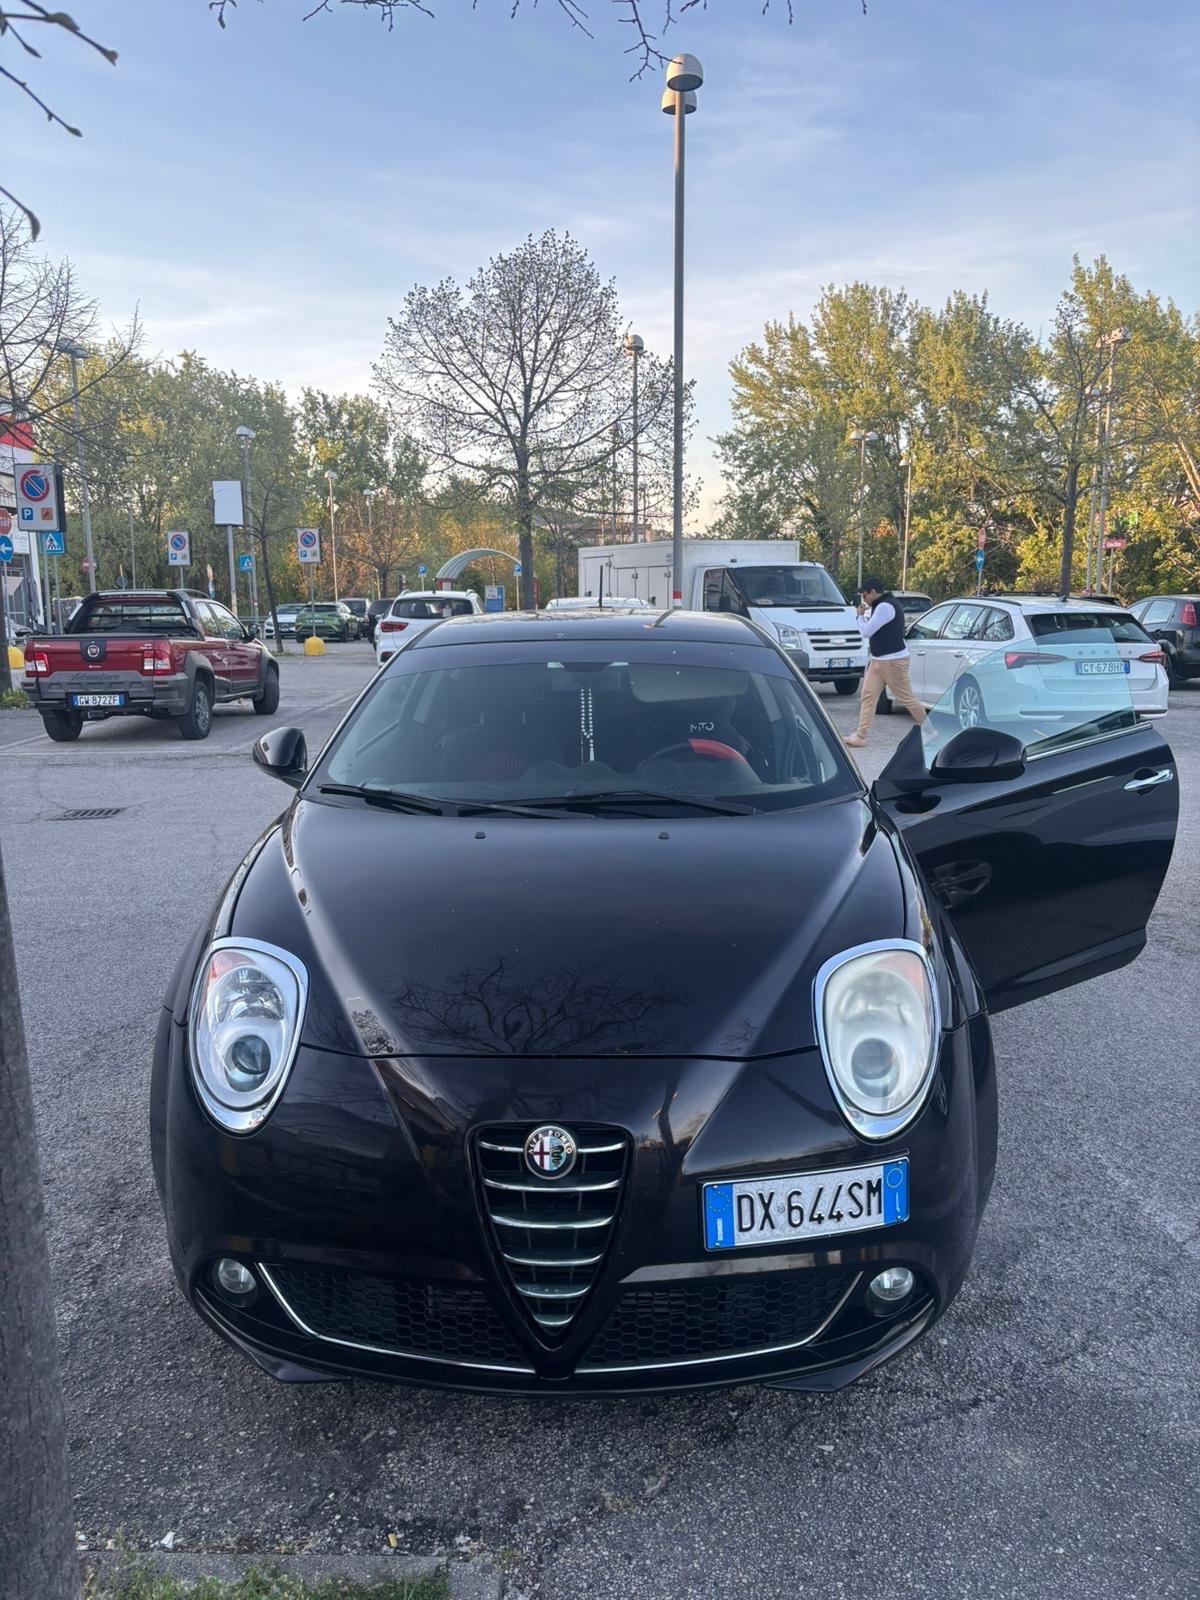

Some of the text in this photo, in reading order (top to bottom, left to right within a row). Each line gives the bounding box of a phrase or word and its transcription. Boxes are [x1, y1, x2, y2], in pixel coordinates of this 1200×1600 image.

[23, 508, 32, 519] P
[528, 1130, 572, 1155] ALFA ROMEO
[737, 1177, 882, 1232] DX 644SM
